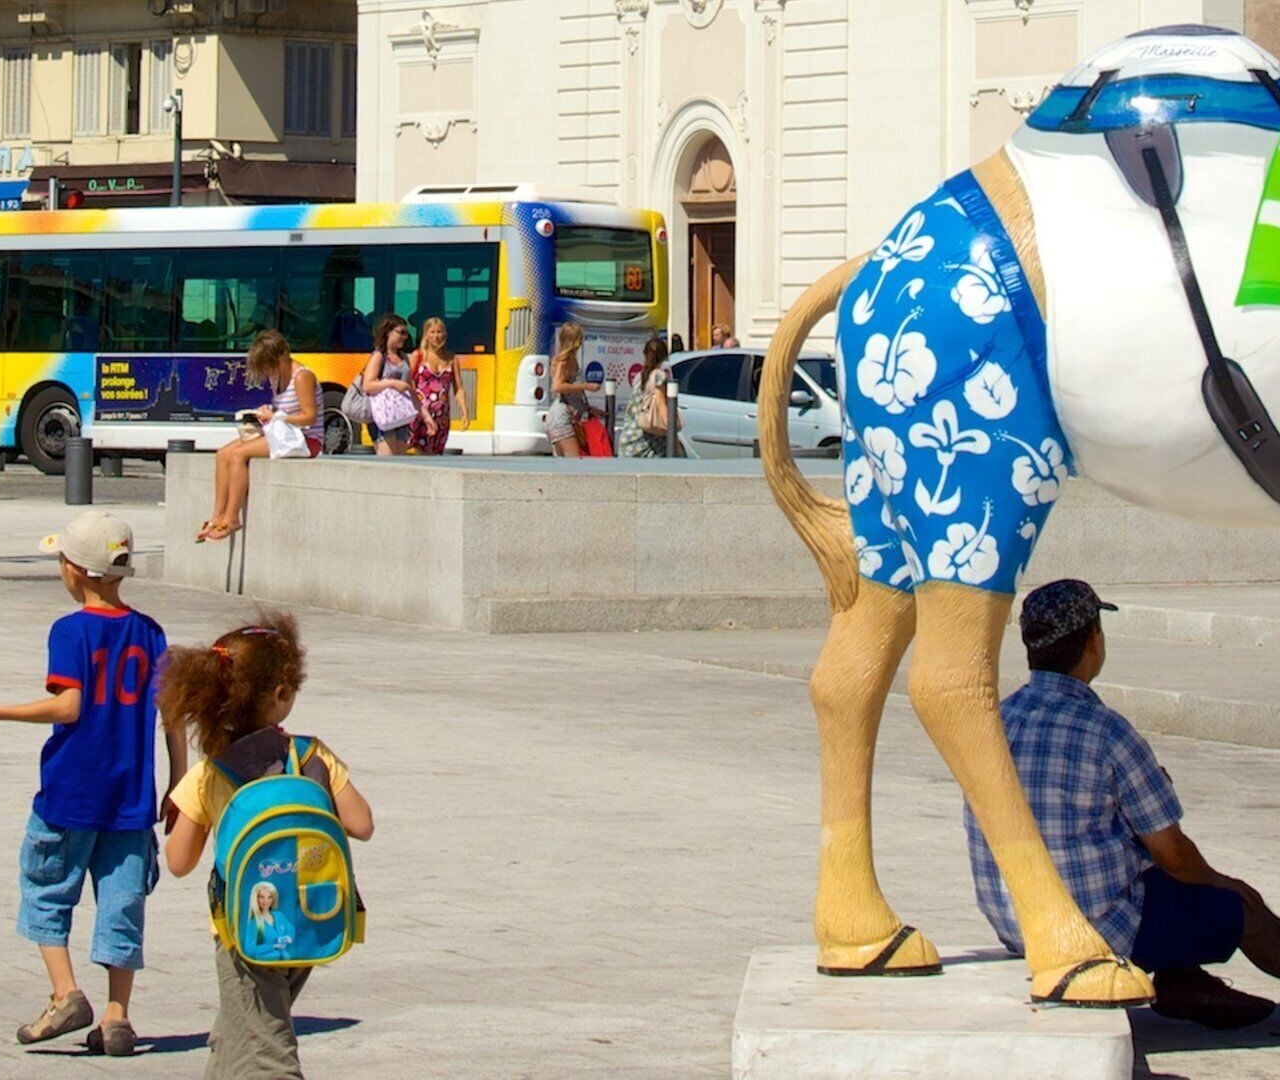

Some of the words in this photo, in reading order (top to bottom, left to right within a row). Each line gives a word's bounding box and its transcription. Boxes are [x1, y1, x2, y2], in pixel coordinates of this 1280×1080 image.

[1139, 43, 1218, 58] Marseille
[101, 376, 136, 389] prolonge
[101, 389, 115, 400] vos
[92, 644, 149, 706] 10
